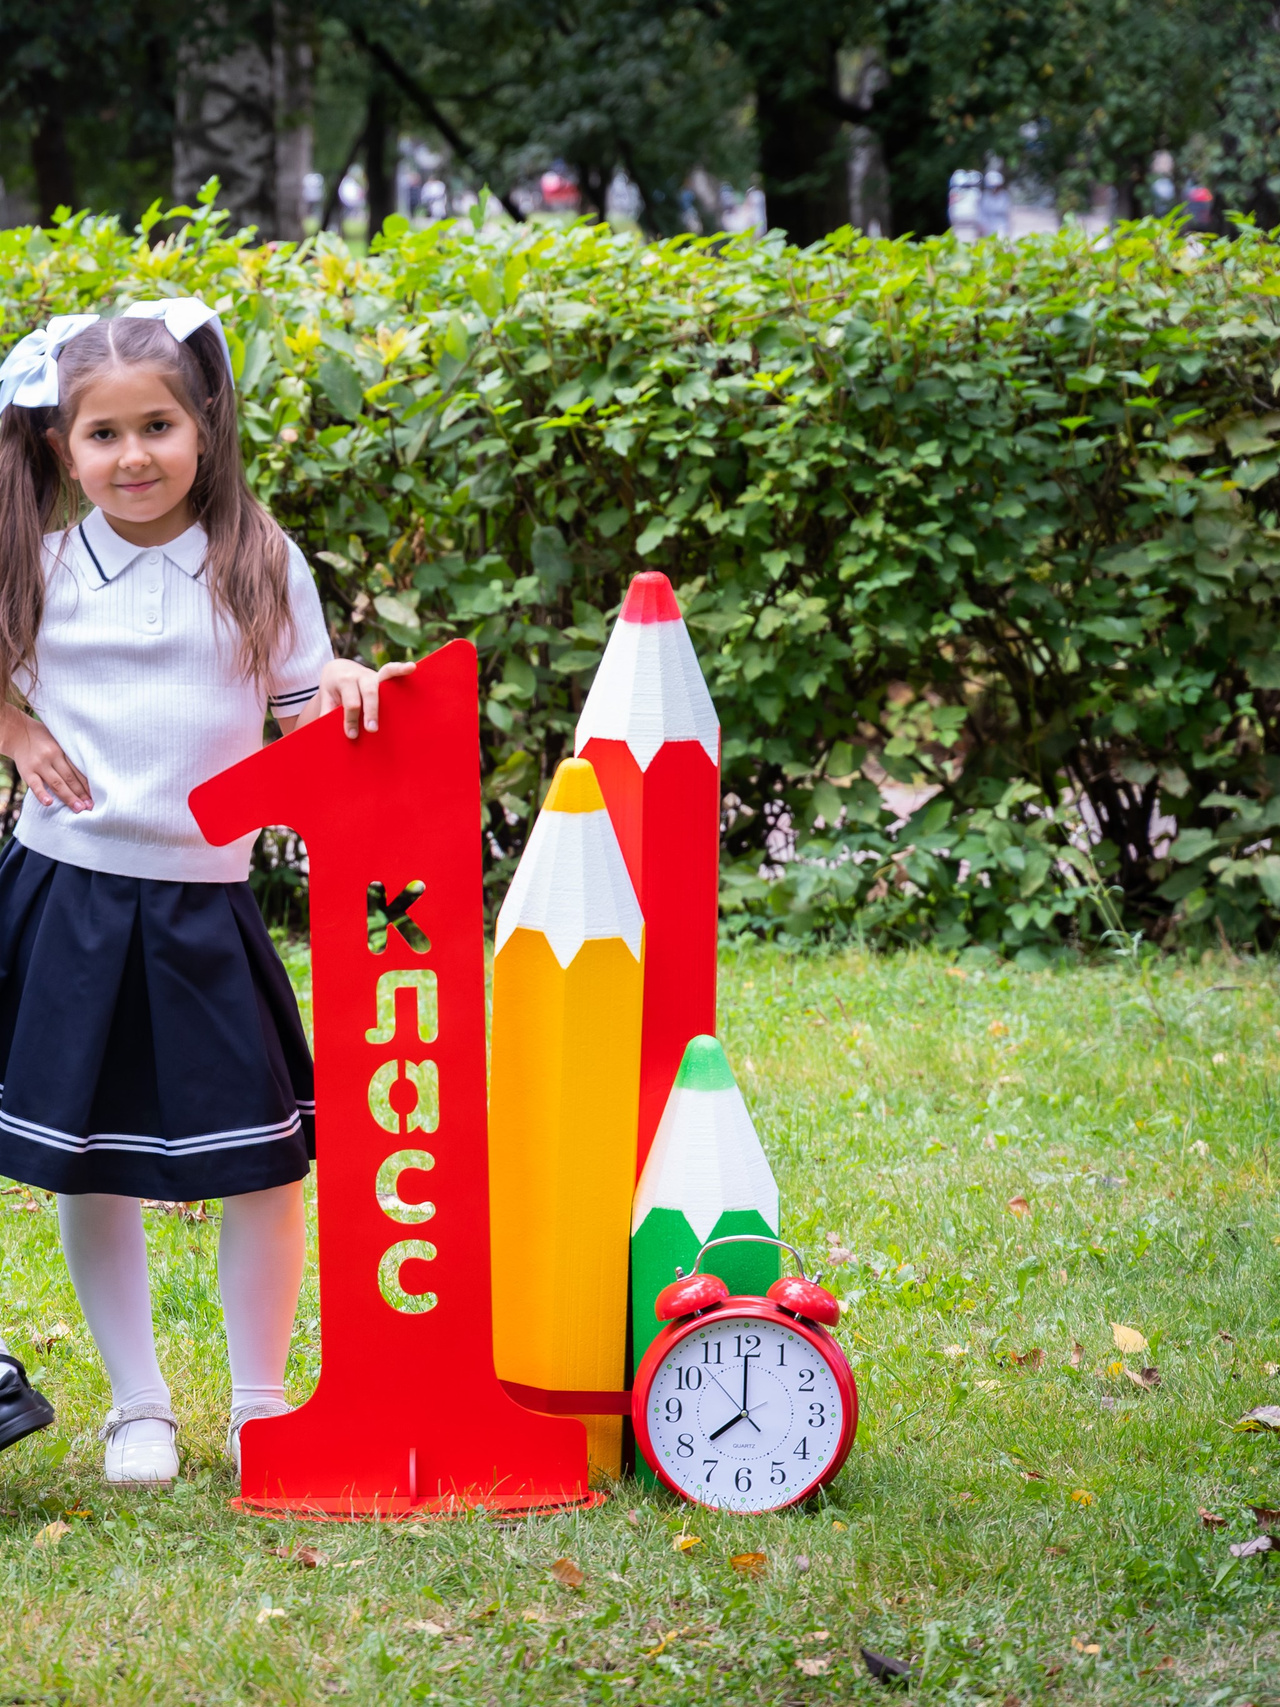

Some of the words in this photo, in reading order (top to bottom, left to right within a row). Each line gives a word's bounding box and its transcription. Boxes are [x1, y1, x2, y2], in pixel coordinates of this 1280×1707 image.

[702, 1342, 724, 1364] 11
[733, 1335, 761, 1358] 12
[777, 1344, 788, 1367] 1
[674, 1366, 702, 1390] 10
[798, 1369, 815, 1392] 2
[665, 1398, 682, 1423] 9
[808, 1403, 825, 1427] 3
[676, 1433, 694, 1458] 8
[793, 1437, 810, 1460] 4
[702, 1460, 718, 1482] 7
[735, 1467, 752, 1492] 6
[770, 1462, 786, 1485] 5
